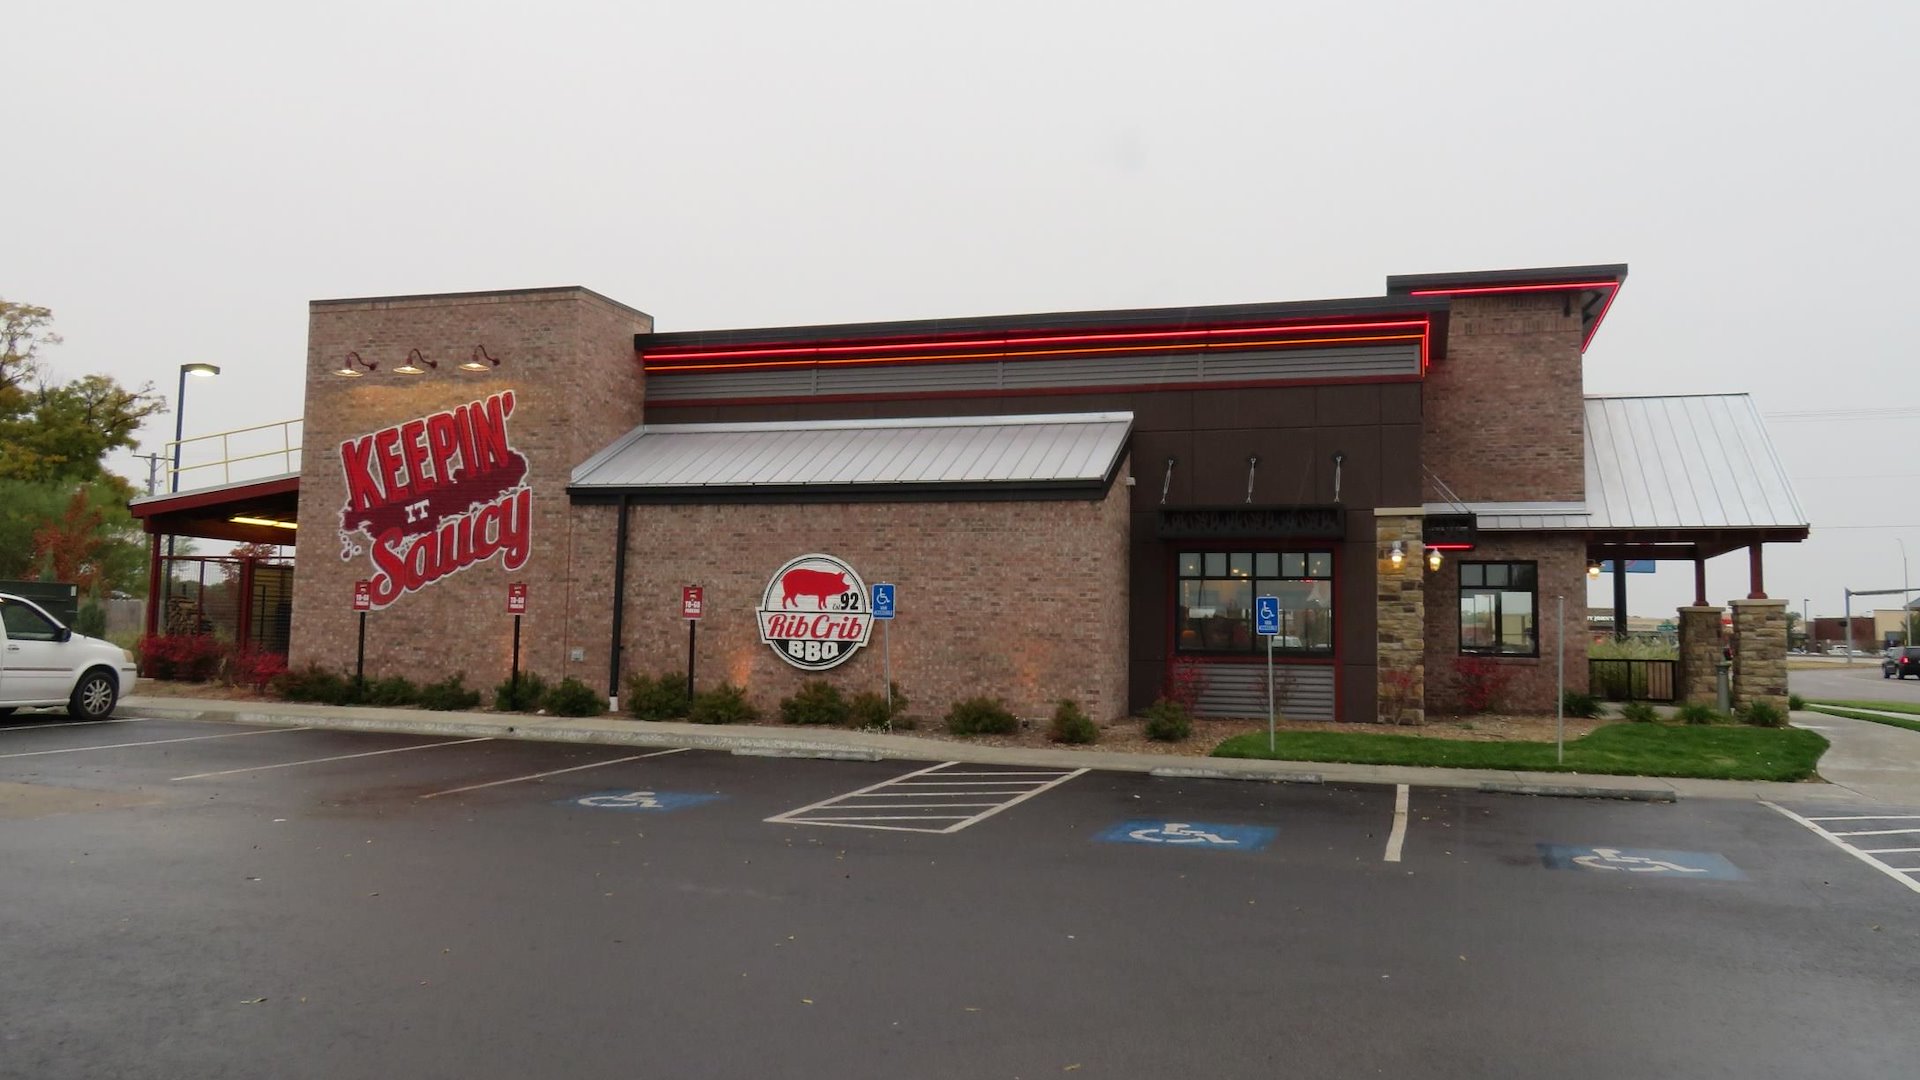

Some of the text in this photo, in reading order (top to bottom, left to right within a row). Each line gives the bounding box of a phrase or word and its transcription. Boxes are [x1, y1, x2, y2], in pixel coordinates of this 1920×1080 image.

[340, 390, 515, 512] KEEPIN'
[405, 499, 430, 523] IT
[370, 486, 532, 609] Saucy
[840, 592, 859, 610] 92
[788, 640, 839, 662] BBQ
